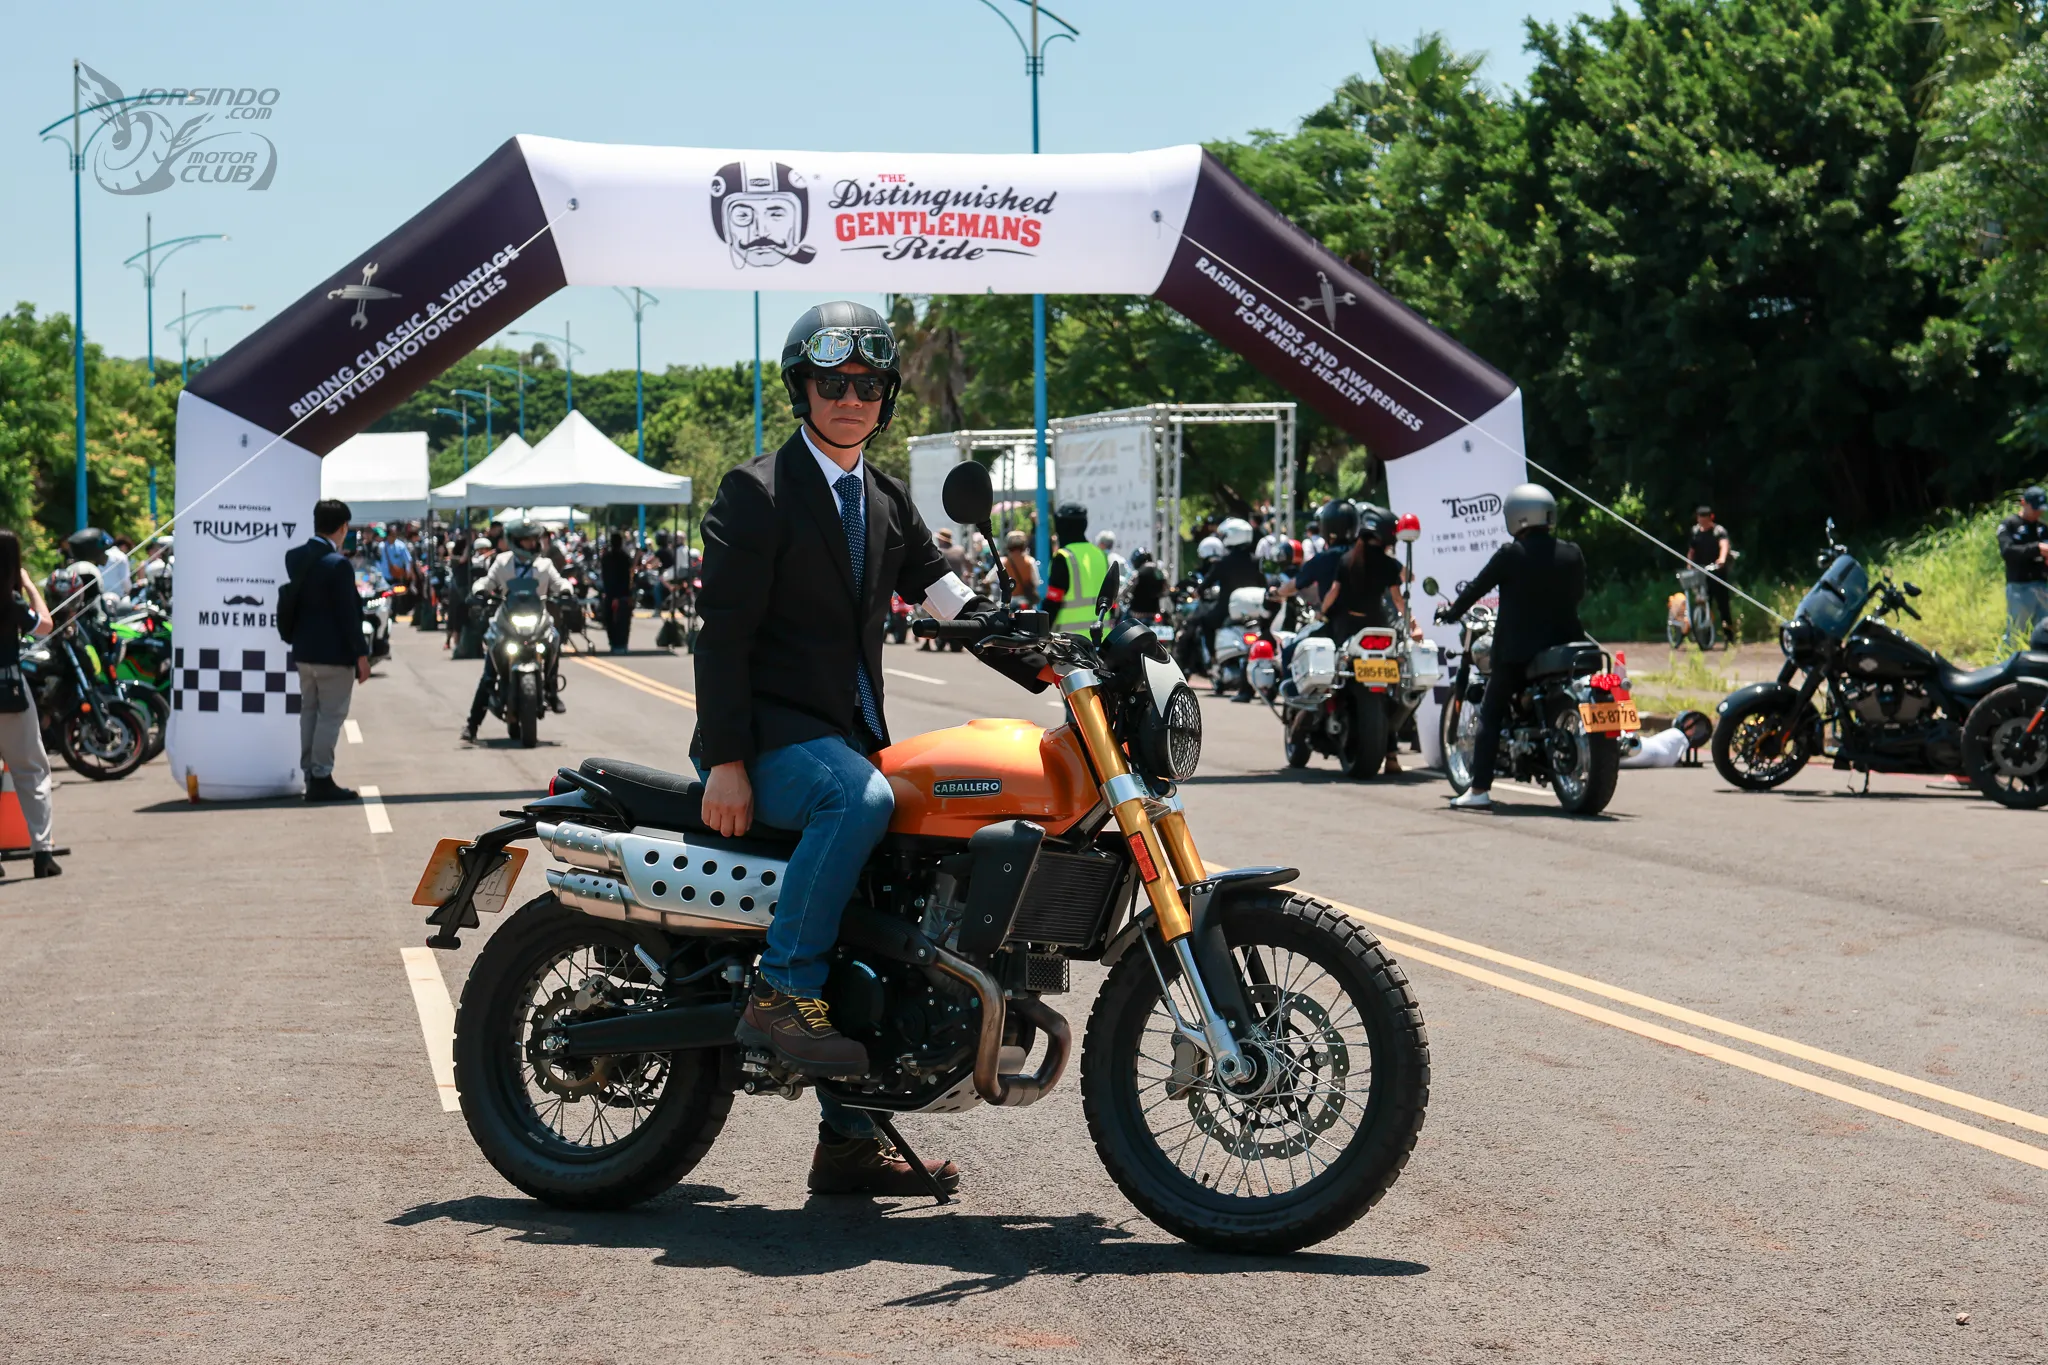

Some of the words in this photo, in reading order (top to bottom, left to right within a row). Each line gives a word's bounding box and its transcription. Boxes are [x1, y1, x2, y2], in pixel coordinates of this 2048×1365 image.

[878, 173, 906, 183] THE
[828, 178, 1058, 217] Distinguished
[835, 211, 1043, 248] GENTLEMAN'S
[882, 235, 987, 261] Ride
[289, 365, 355, 419] RIDING
[356, 312, 427, 369] CLASSIC
[425, 302, 442, 317] &
[440, 243, 520, 304] VINTAGE
[324, 367, 386, 415] STYLED
[388, 274, 508, 370] MOTORCYCLES
[1195, 256, 1256, 307] RAISING
[1255, 303, 1306, 344] FUNDS
[1303, 341, 1339, 368] AND
[1337, 366, 1424, 432] AWARENESS
[1234, 305, 1267, 333] FOR
[1264, 329, 1313, 367] MEN'S
[1311, 363, 1366, 406] HEALTH
[239, 504, 271, 512] SPONSOR
[1464, 515, 1486, 523] CAFE
[193, 520, 278, 543] TRIUMPH
[1467, 529, 1485, 538] TON
[199, 611, 278, 628] MOVEMBE
[1582, 709, 1637, 726] LAS-8778
[934, 782, 999, 793] CABALLERO
